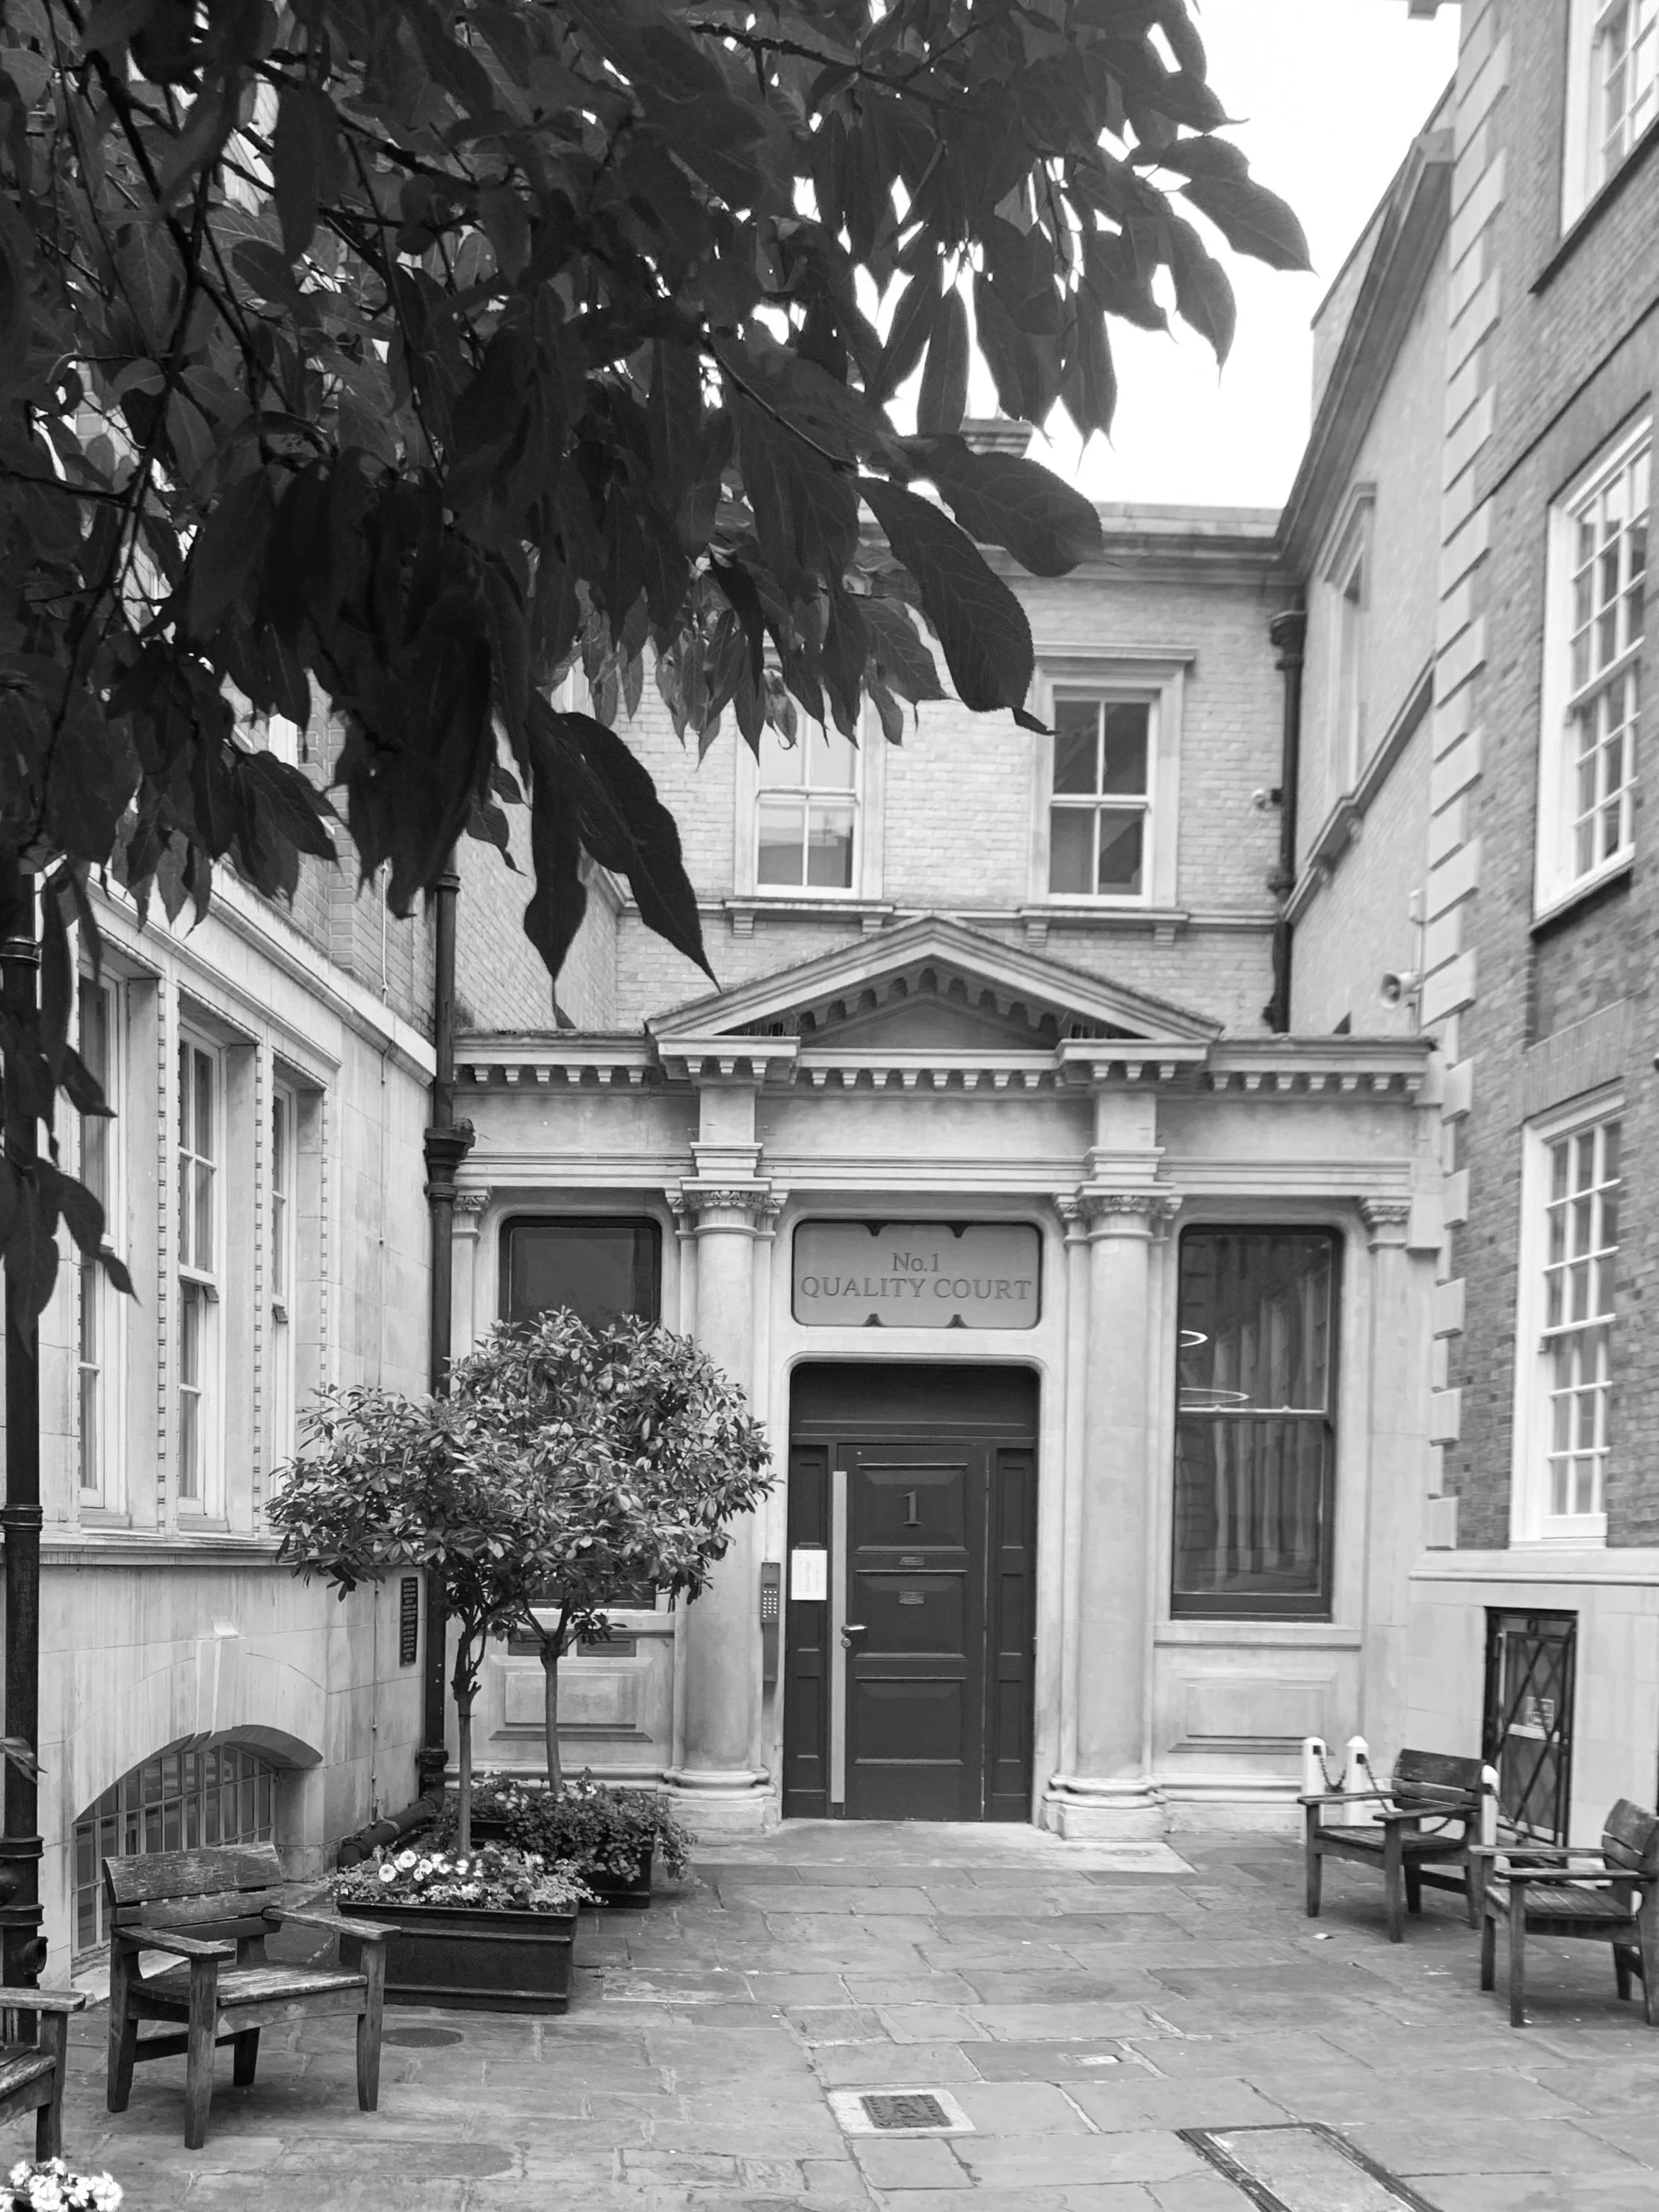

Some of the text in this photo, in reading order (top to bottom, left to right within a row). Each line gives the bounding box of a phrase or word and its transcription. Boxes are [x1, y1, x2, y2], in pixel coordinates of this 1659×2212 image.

[800, 1277, 1031, 1299] QUALITY COURT
[902, 1490, 922, 1525] 1
